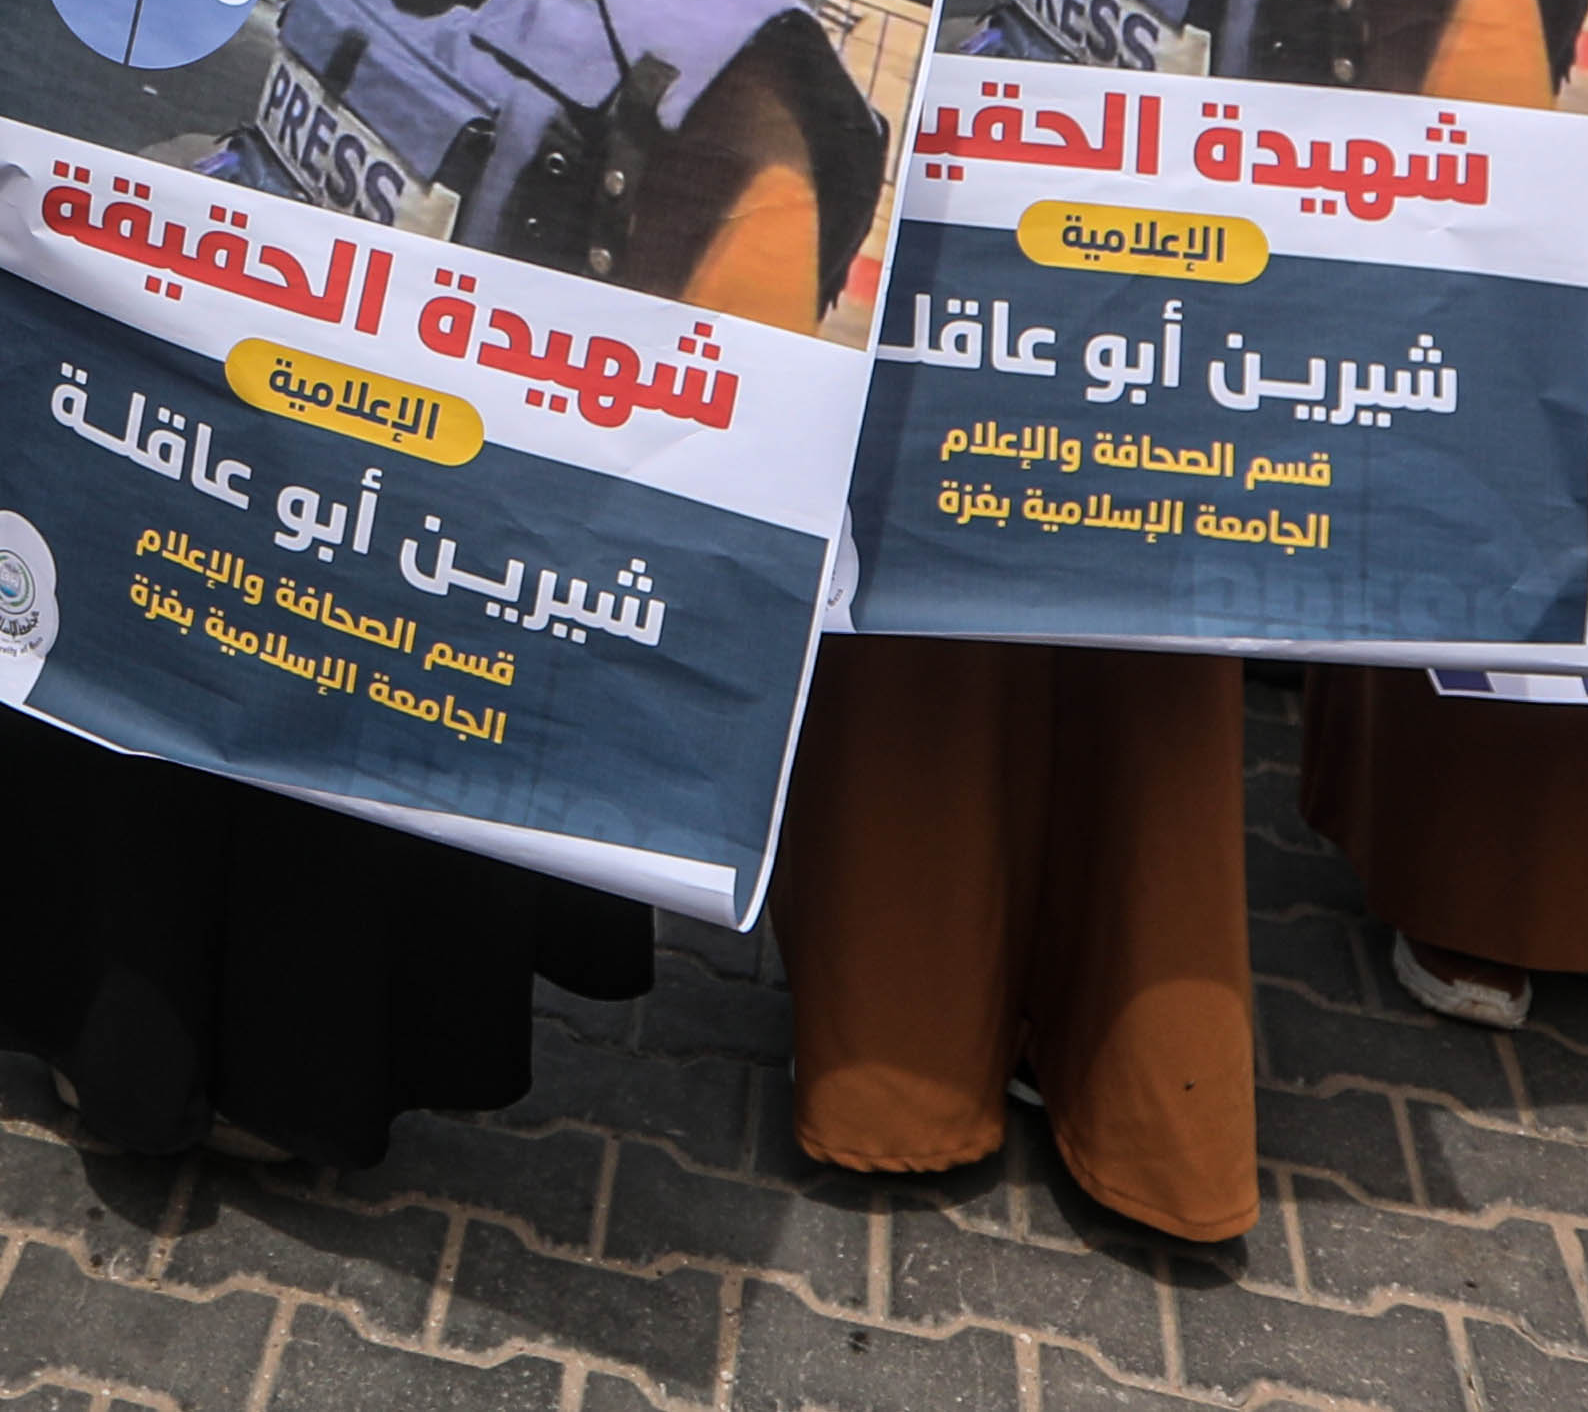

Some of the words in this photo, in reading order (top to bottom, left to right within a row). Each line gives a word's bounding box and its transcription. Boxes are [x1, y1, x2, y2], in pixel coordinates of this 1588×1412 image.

[265, 62, 406, 227] PRESS
[914, 81, 1160, 181] الحقي
[1195, 103, 1488, 221] شهيدة
[43, 161, 392, 335] الحقيقة
[1062, 215, 1224, 271] الإعلامية
[420, 269, 738, 429] شهيدة
[877, 294, 1056, 376] عاقل
[1085, 300, 1182, 404] أبو
[269, 358, 440, 443] الإعلامية
[1210, 334, 1456, 427] شيرين
[52, 363, 251, 509] عاقلة
[940, 421, 1083, 473] والإعلام
[1093, 433, 1235, 478] الصحافة
[1245, 452, 1332, 491] قسم
[275, 468, 382, 562] أبو
[937, 481, 1012, 527] بغزة
[1022, 489, 1185, 543] الإسلامية
[1195, 505, 1331, 555] الجامعة
[129, 574, 196, 635] بغزة
[136, 529, 266, 606] والإعلام
[401, 516, 665, 645] شيرين
[204, 607, 359, 695] الإسلامية
[274, 577, 418, 654] الصحافة
[424, 642, 516, 686] قسم
[368, 673, 508, 744] الجامعة
